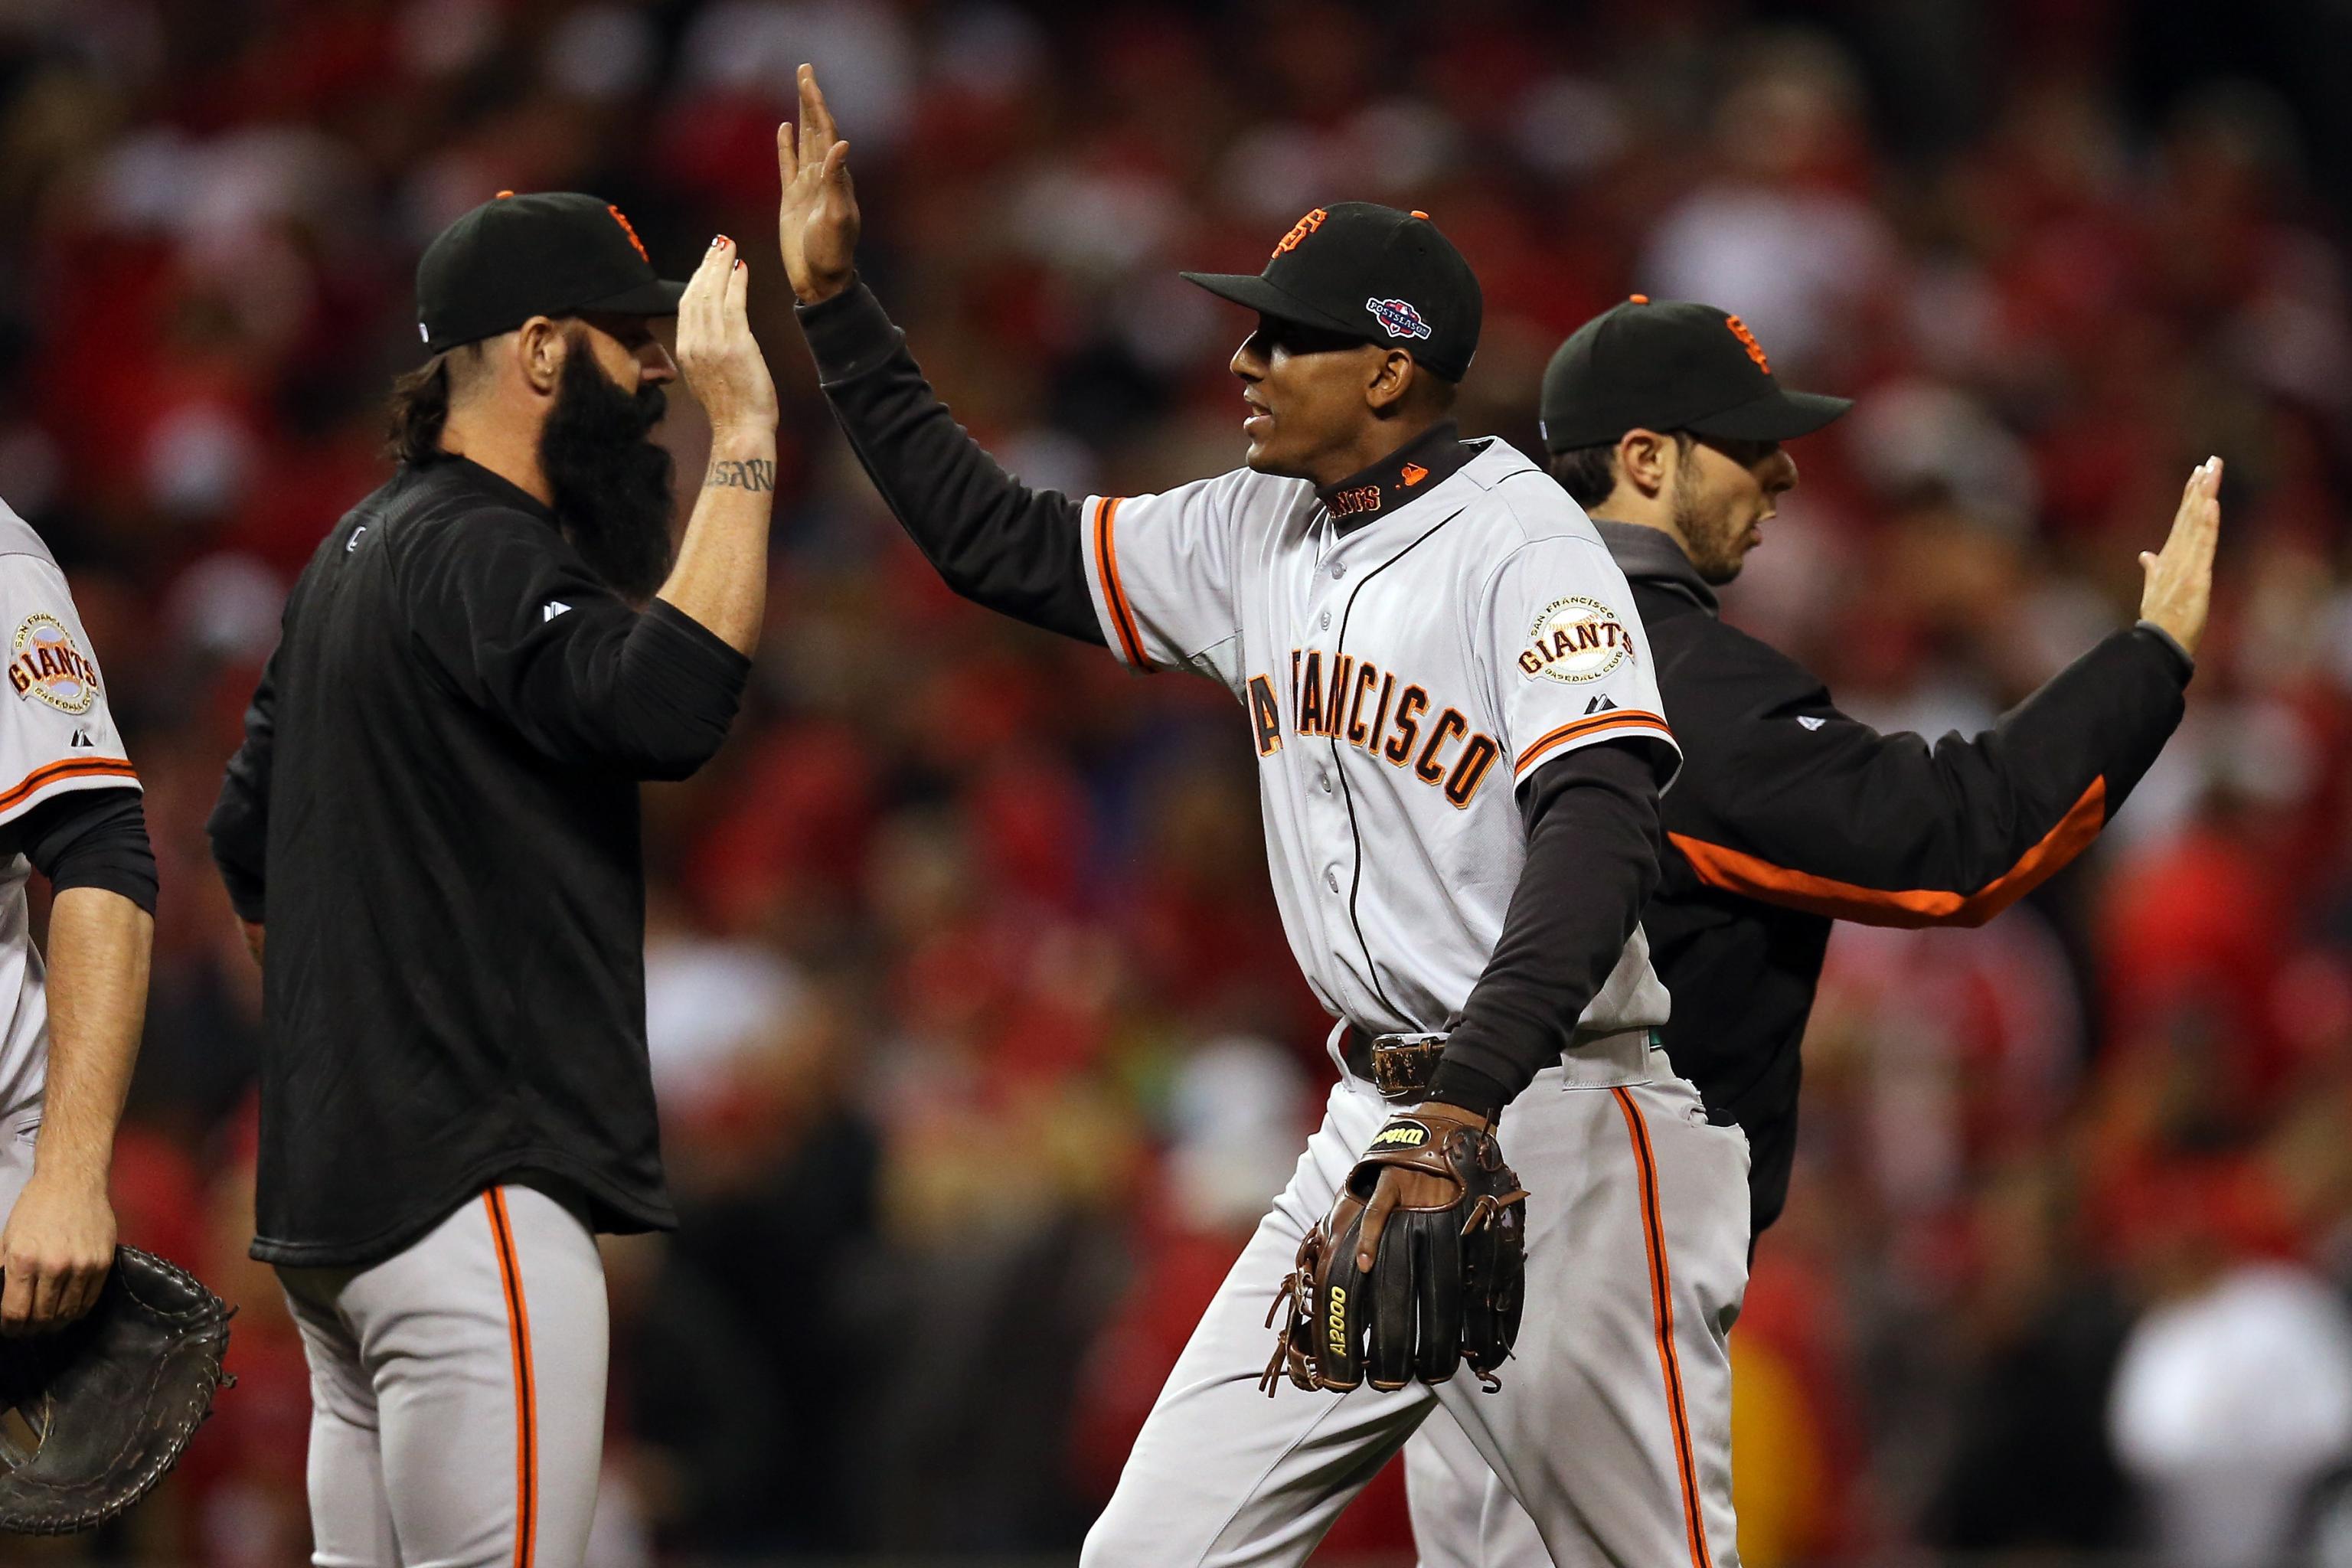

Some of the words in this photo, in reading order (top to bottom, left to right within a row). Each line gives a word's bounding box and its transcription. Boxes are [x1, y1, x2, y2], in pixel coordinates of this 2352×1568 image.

[1369, 301, 1429, 337] POSTSEASON
[15, 625, 29, 649] SAN
[1530, 615, 1546, 637] SAN
[1546, 596, 1615, 619] FRANCISCO
[1517, 621, 1635, 675] GIANTS
[1544, 668, 1602, 682] BASEBALL
[1602, 652, 1623, 673] CLUB
[8, 645, 98, 694] GIANTS
[1329, 1285, 1347, 1357] A2000
